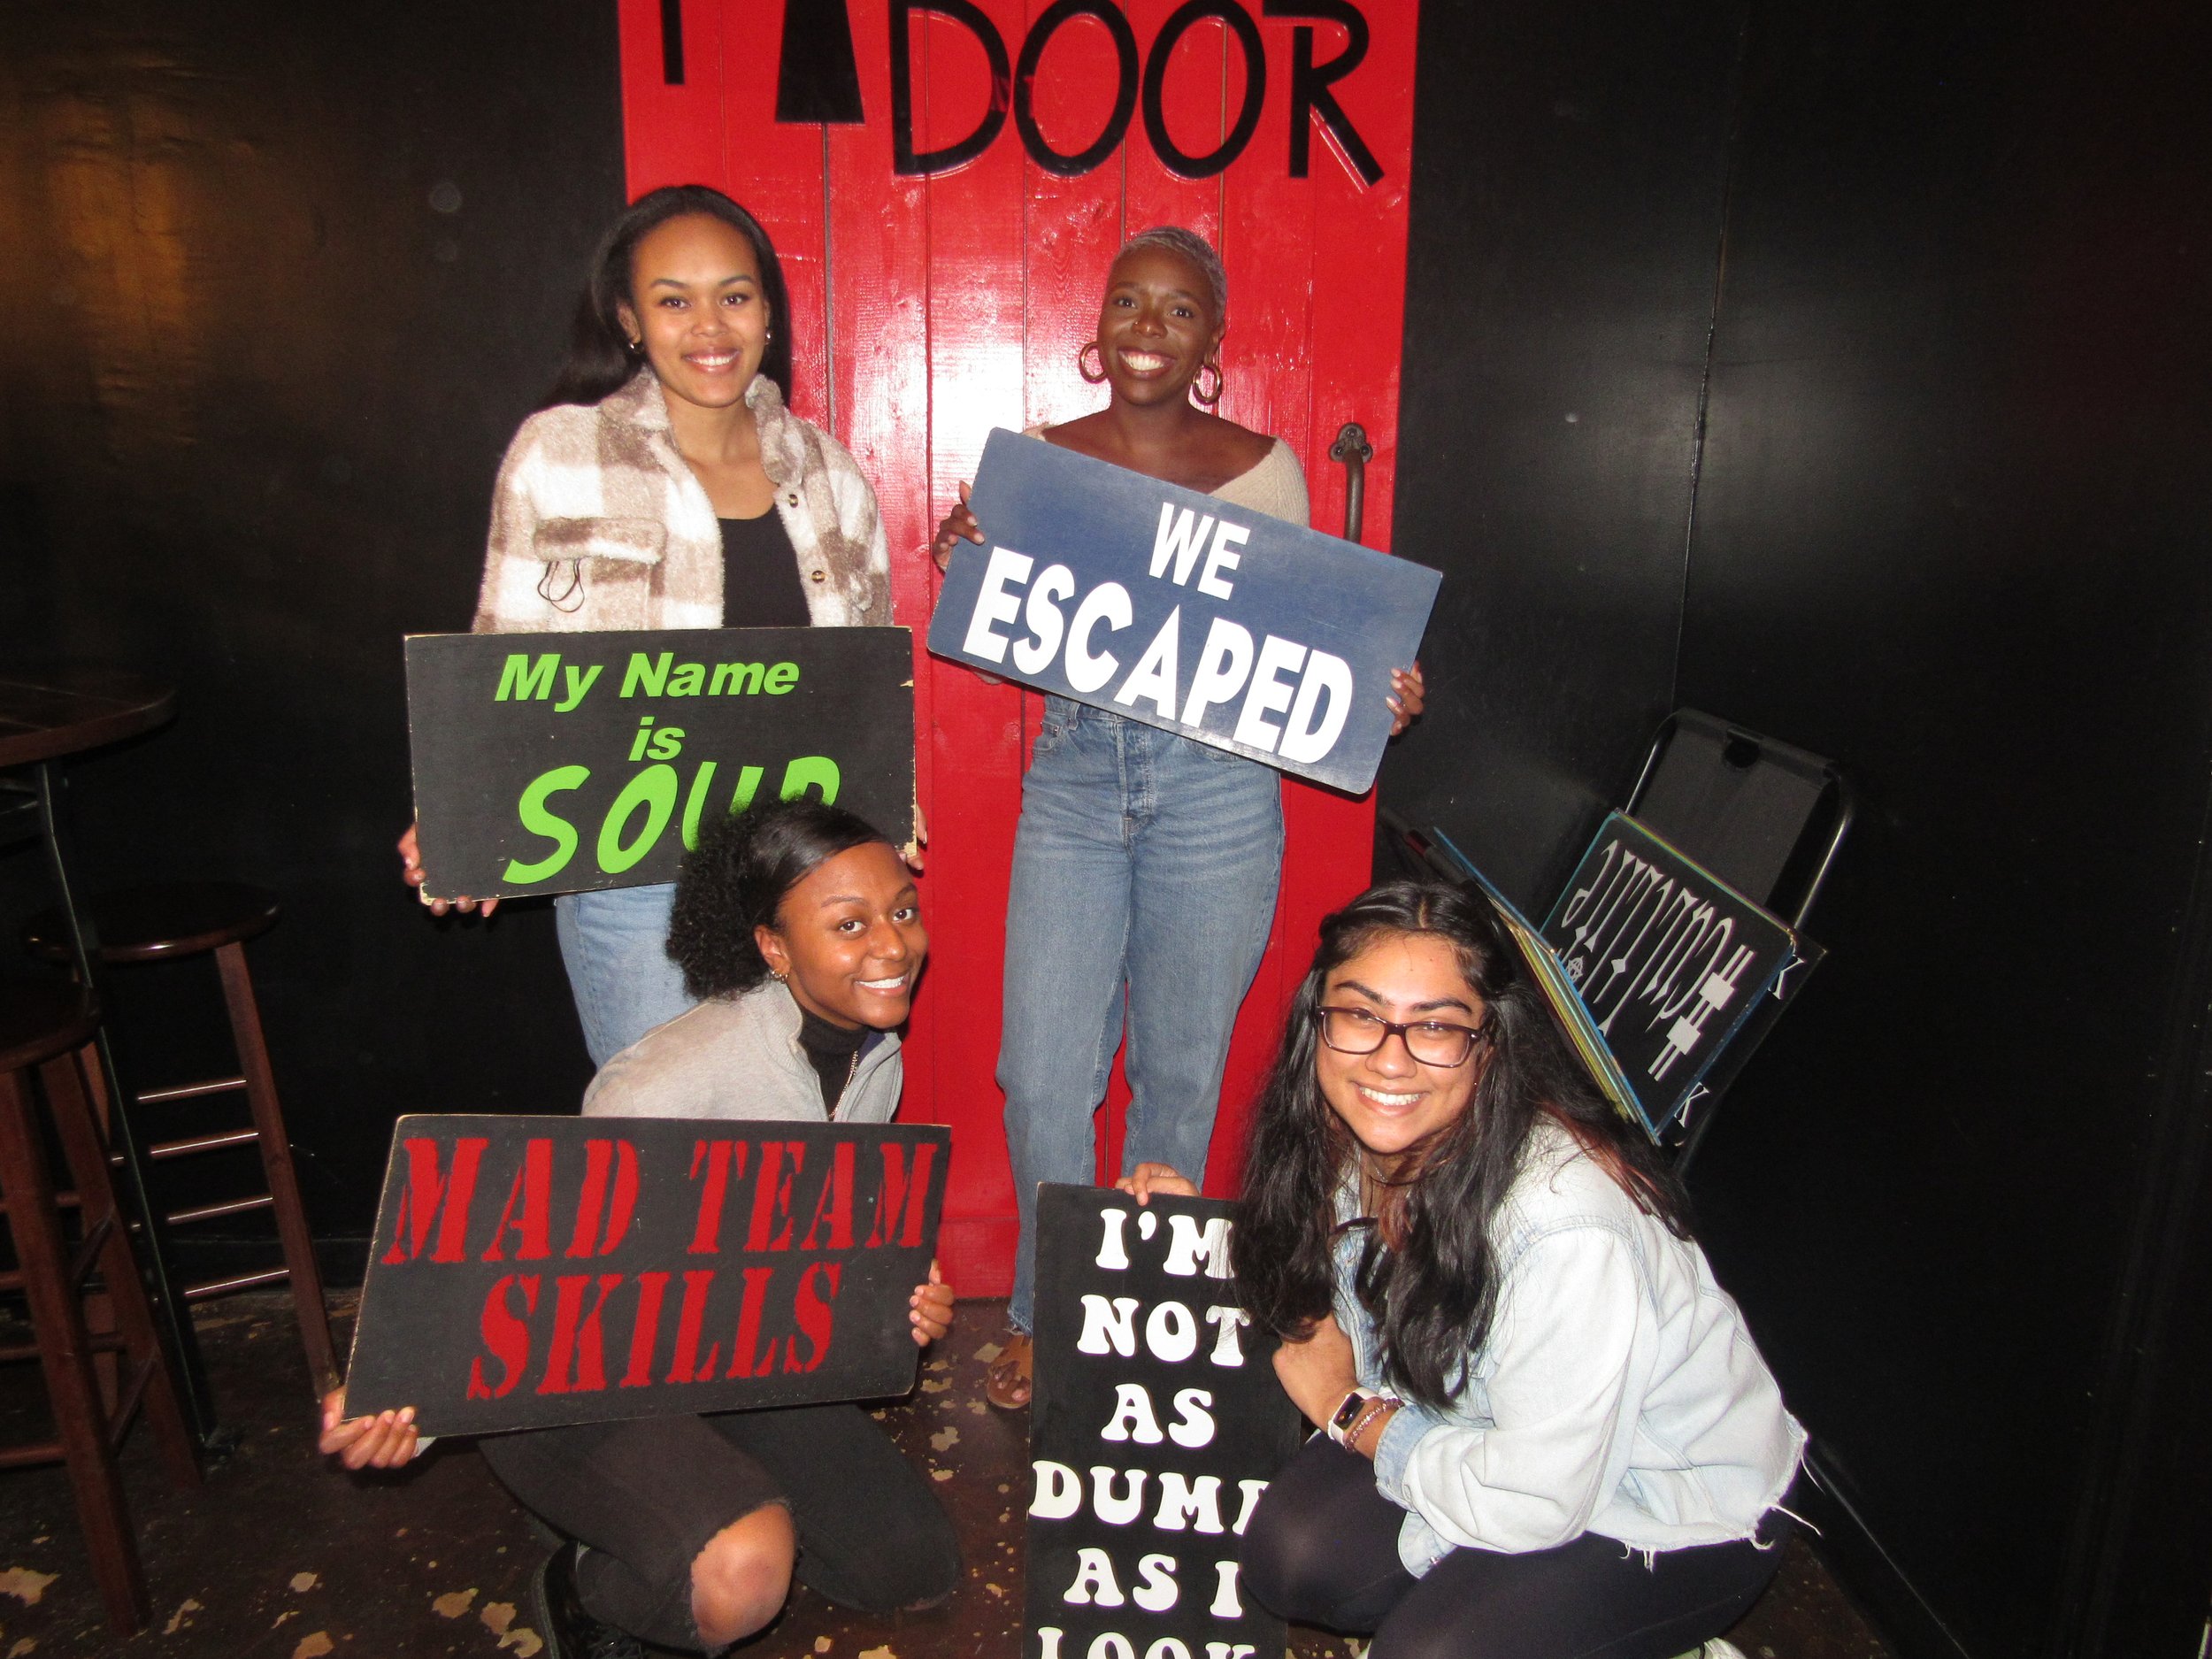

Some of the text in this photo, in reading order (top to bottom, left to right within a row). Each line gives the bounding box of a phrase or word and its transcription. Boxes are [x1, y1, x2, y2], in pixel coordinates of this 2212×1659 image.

[888, 0, 1385, 187] DOOR
[1148, 502, 1251, 601] WE
[495, 651, 801, 712] My Name
[962, 545, 1354, 764] ESCAPED
[627, 716, 685, 762] is
[381, 1137, 939, 1265] MAD TEAM
[1094, 1208, 1235, 1279] I'M
[466, 1261, 842, 1400] SKILLS
[1077, 1294, 1250, 1367] NOT
[1100, 1383, 1216, 1448] AS
[1063, 1548, 1243, 1618] AS I
